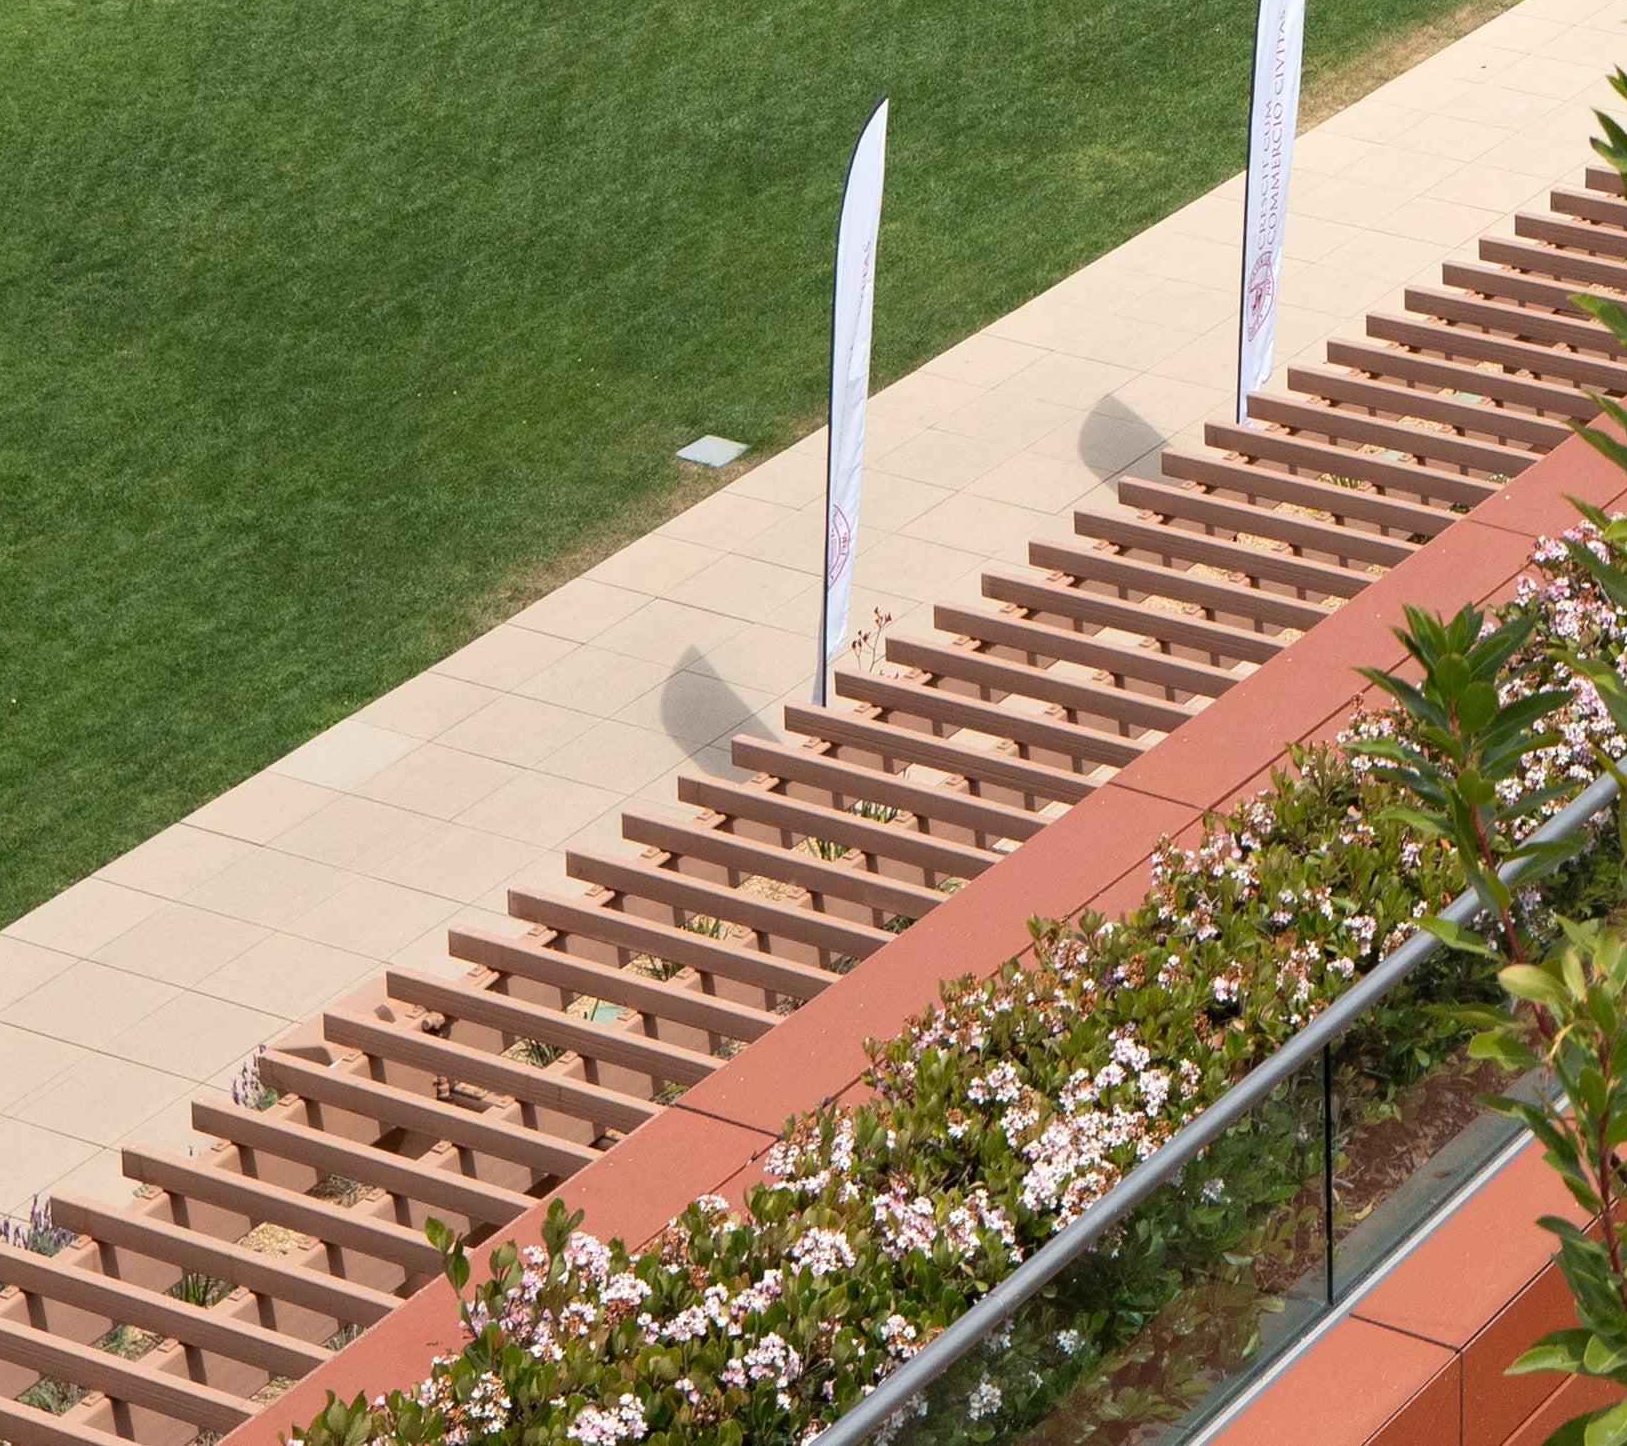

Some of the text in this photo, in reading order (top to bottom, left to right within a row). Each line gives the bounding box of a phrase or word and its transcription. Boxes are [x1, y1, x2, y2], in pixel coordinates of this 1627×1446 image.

[1258, 101, 1273, 250] CRESCIT CUM
[1266, 10, 1286, 245] COMMERCIO CIVITAS
